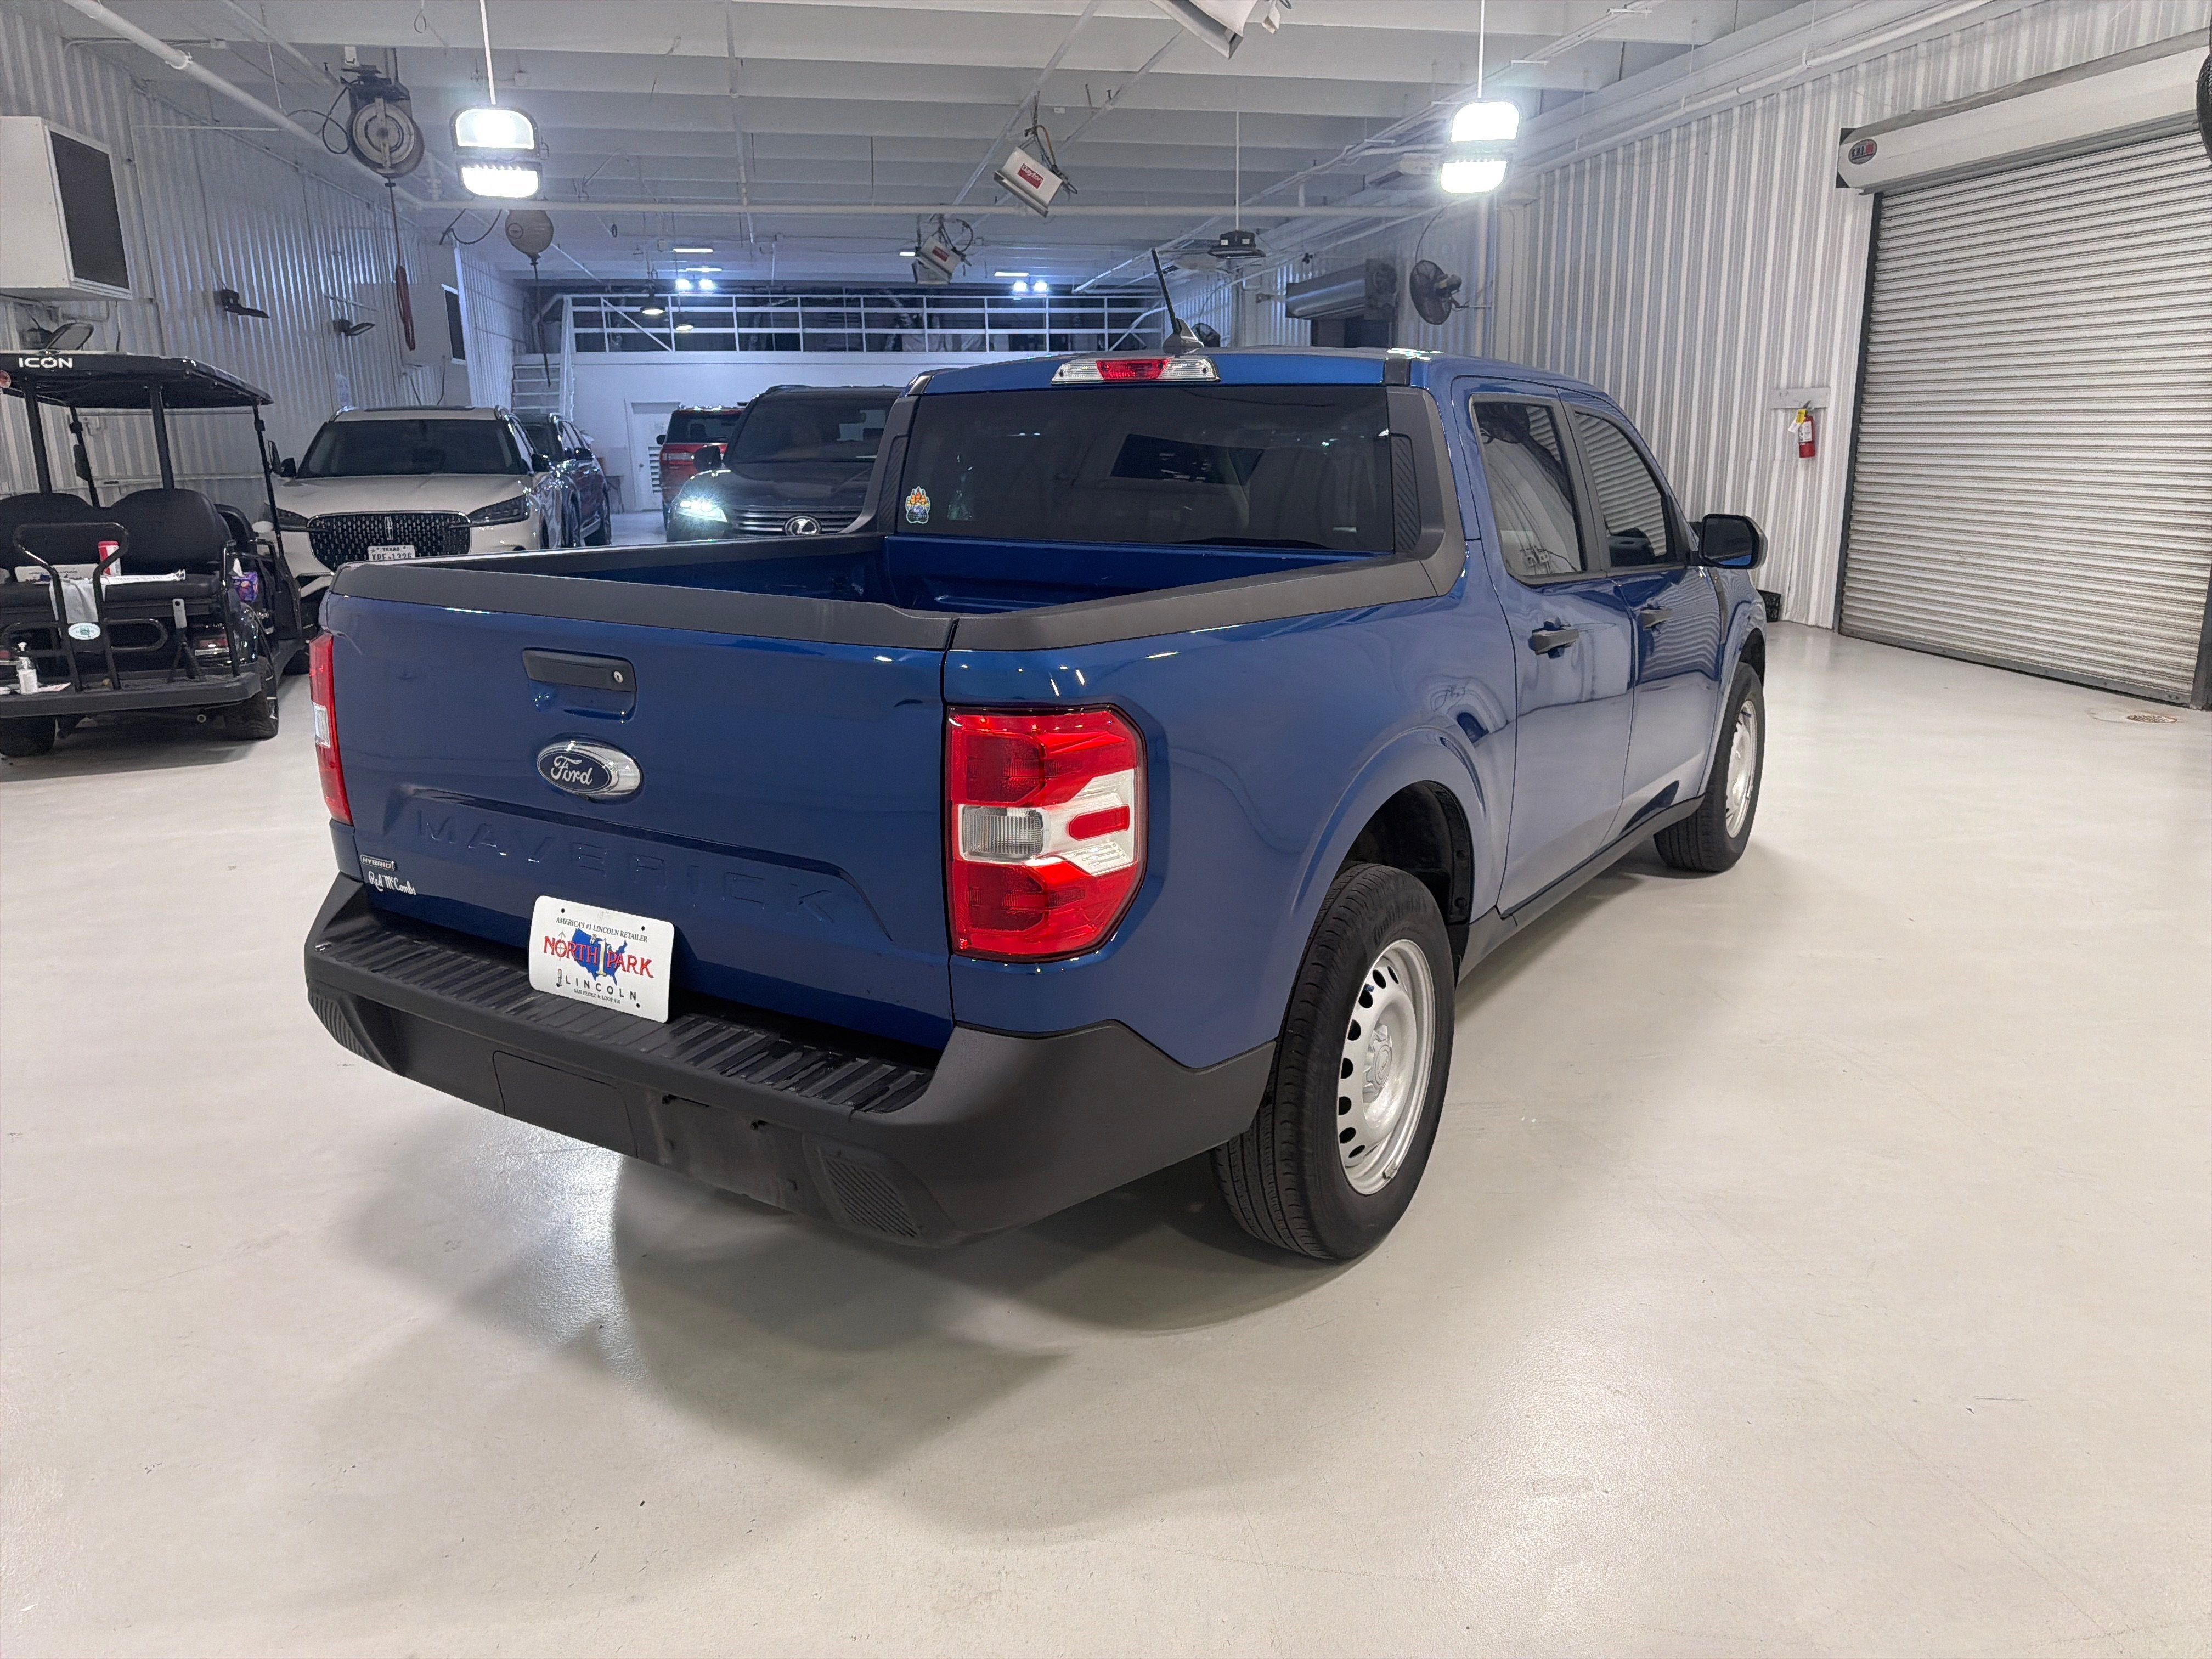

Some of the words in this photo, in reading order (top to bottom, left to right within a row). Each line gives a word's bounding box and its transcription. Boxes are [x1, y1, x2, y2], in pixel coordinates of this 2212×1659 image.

[1021, 165, 1042, 183] Dayton
[18, 357, 73, 368] ICON
[550, 755, 592, 785] Ford
[362, 856, 392, 869] HYBRID
[416, 809, 836, 924] MAVERICK
[369, 871, 383, 892] Red
[555, 917, 585, 929] AMERICA'S
[593, 924, 619, 936] LINCOLN
[619, 930, 648, 943] RETAILER
[543, 936, 598, 966] NORTH
[607, 950, 654, 978] PARK
[566, 975, 636, 1001] LINCOLN
[583, 990, 597, 998] PEDRO
